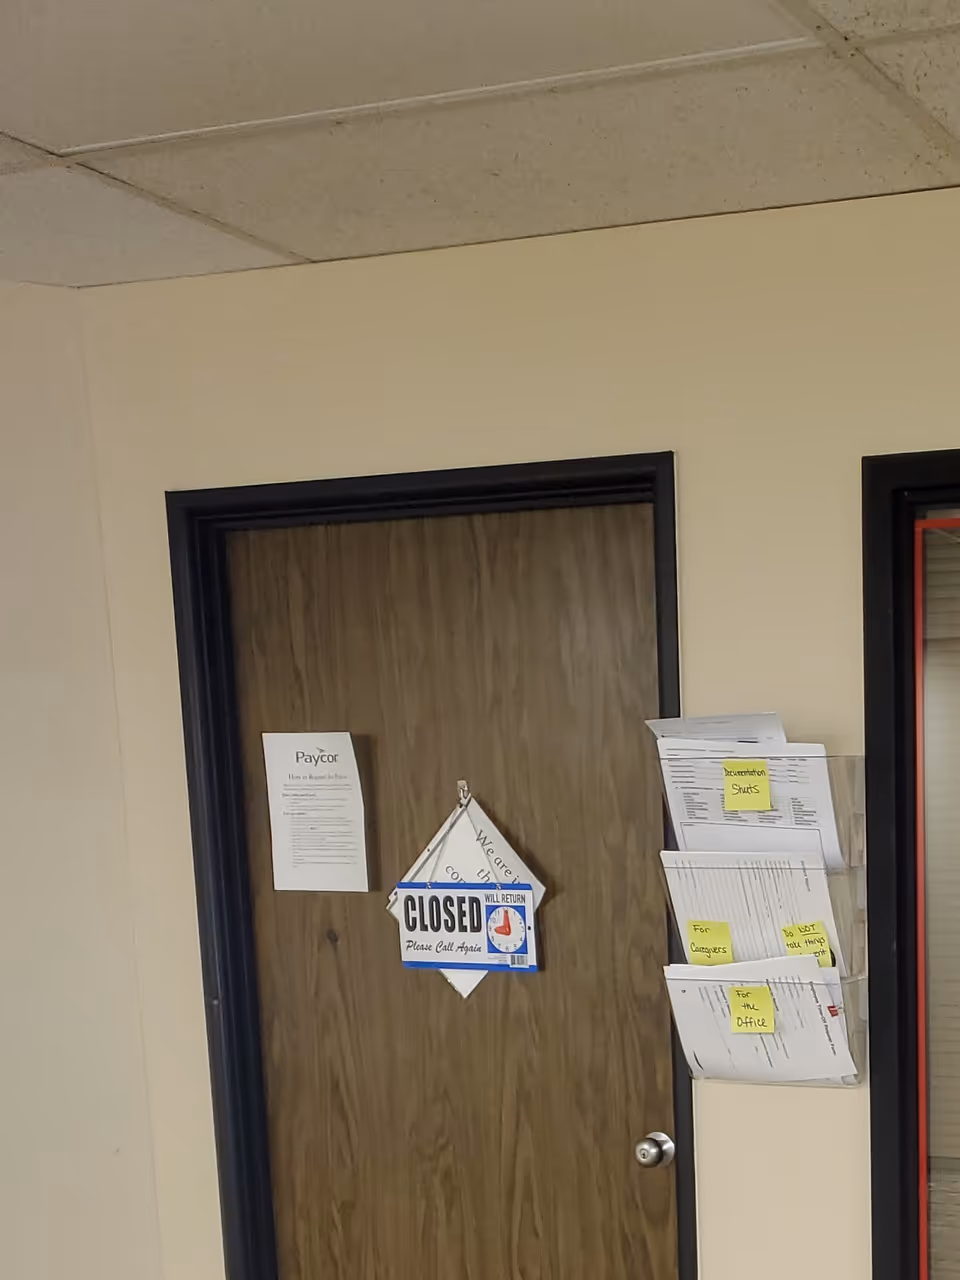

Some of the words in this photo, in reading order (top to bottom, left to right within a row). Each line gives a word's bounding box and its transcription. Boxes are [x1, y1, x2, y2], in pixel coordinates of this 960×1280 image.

[296, 751, 338, 766] Paycor
[476, 829, 495, 857] We
[494, 856, 512, 877] are
[484, 893, 500, 904] WILL
[502, 893, 525, 904] RETURN
[404, 895, 482, 933] CLOSED
[692, 924, 711, 933] For
[782, 928, 794, 937] Do
[406, 940, 432, 952] Please
[435, 941, 454, 953] Call
[455, 943, 482, 954] Again
[804, 937, 826, 947] things
[690, 941, 727, 958] Caregivers
[735, 990, 752, 998] For
[741, 1002, 760, 1011] the
[736, 1016, 768, 1028] Office
